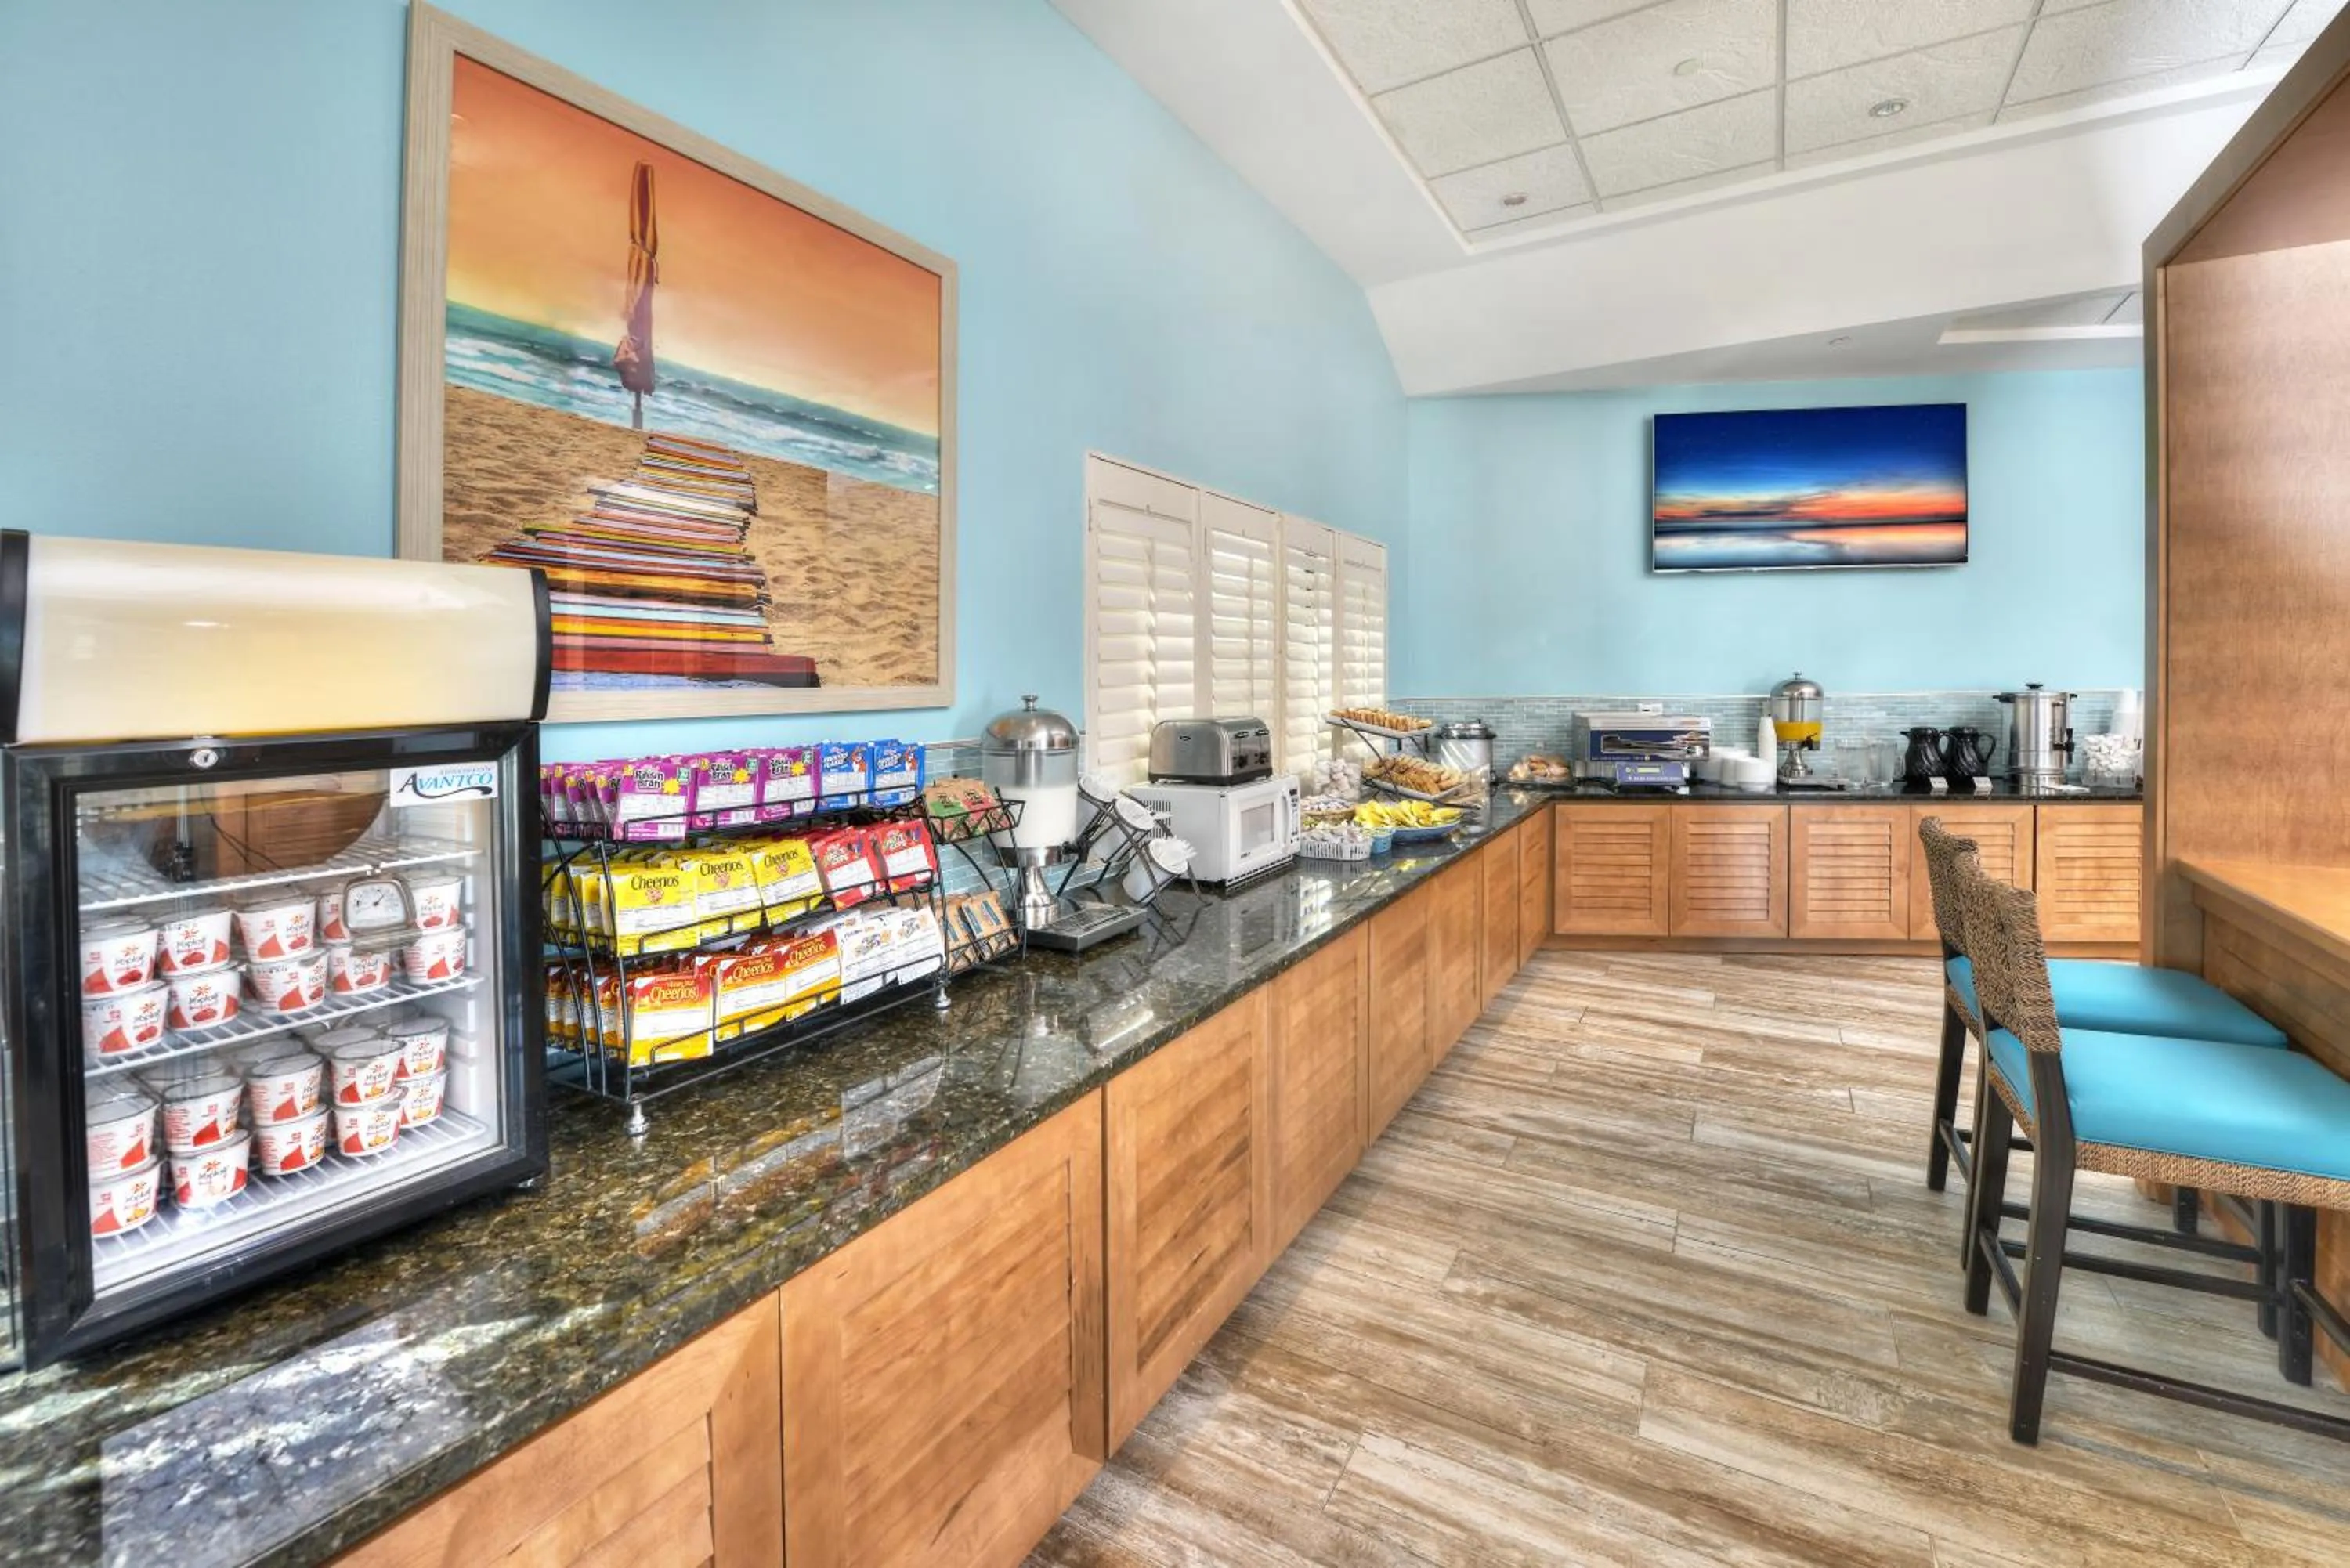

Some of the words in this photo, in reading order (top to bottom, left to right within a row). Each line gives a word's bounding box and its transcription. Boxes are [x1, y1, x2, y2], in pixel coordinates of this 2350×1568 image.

[635, 770, 663, 781] Raisin
[638, 780, 660, 789] Bran
[765, 848, 798, 866] Cheerios
[700, 860, 743, 876] Cheerios
[631, 875, 679, 890] Cheerios
[790, 941, 826, 965] Cheerios
[733, 963, 774, 981] Cheerios
[650, 986, 699, 1002] Cheerios
